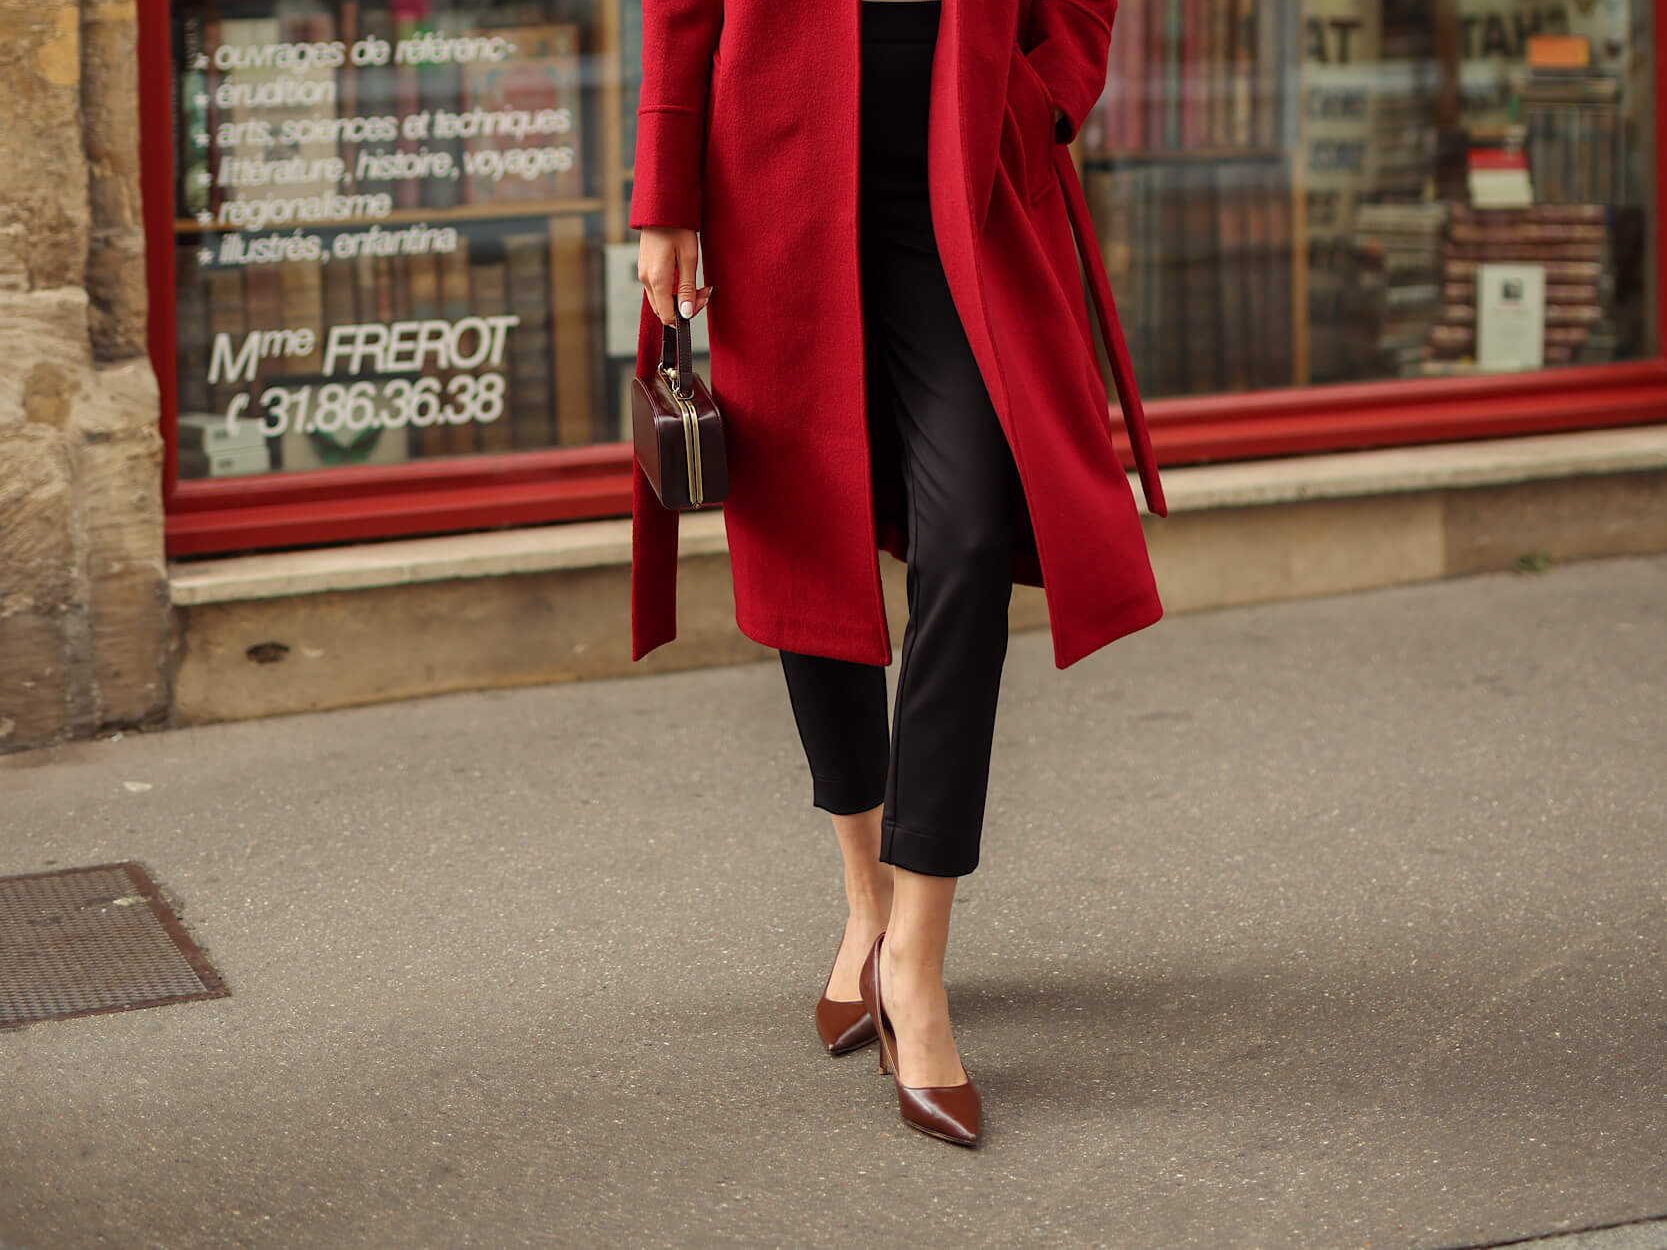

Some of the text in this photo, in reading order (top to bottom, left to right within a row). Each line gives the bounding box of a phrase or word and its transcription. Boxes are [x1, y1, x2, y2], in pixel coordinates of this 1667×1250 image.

[214, 41, 346, 75] ouvrages
[351, 34, 391, 67] de
[216, 76, 337, 109] érudition
[279, 112, 399, 145] sciences
[402, 109, 431, 141] et
[433, 104, 572, 142] techniques
[218, 145, 575, 187] littérature, histoire, voyages
[219, 191, 393, 232] régionalisme
[219, 227, 331, 265] illustrés,
[208, 315, 520, 384] Mme FREROT
[258, 372, 506, 438] 31.86.36.38
